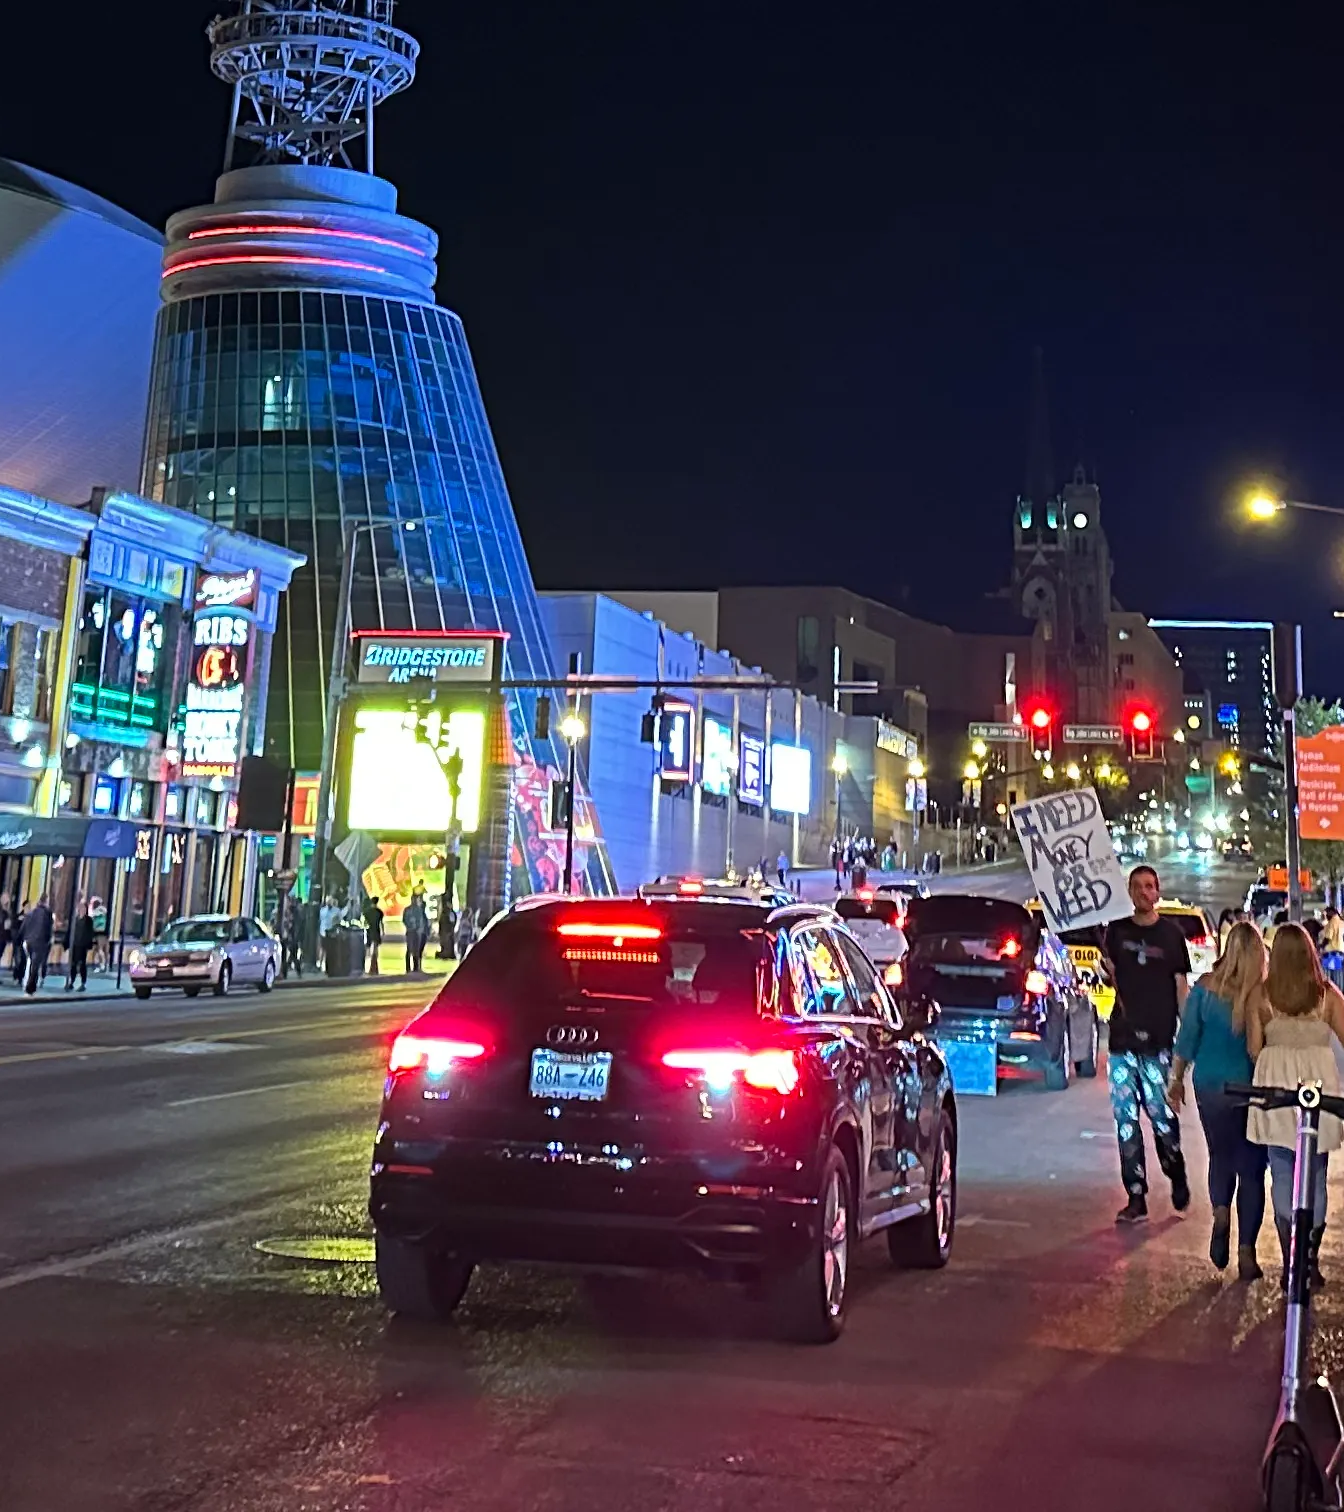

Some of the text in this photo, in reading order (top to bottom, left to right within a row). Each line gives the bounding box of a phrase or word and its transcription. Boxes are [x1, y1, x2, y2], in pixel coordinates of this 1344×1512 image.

[194, 615, 249, 646] RIBS
[363, 644, 487, 667] BRIDGESTONE
[1013, 791, 1098, 837] I NEED
[1029, 830, 1094, 873] MONEY
[1038, 879, 1113, 929] WEED
